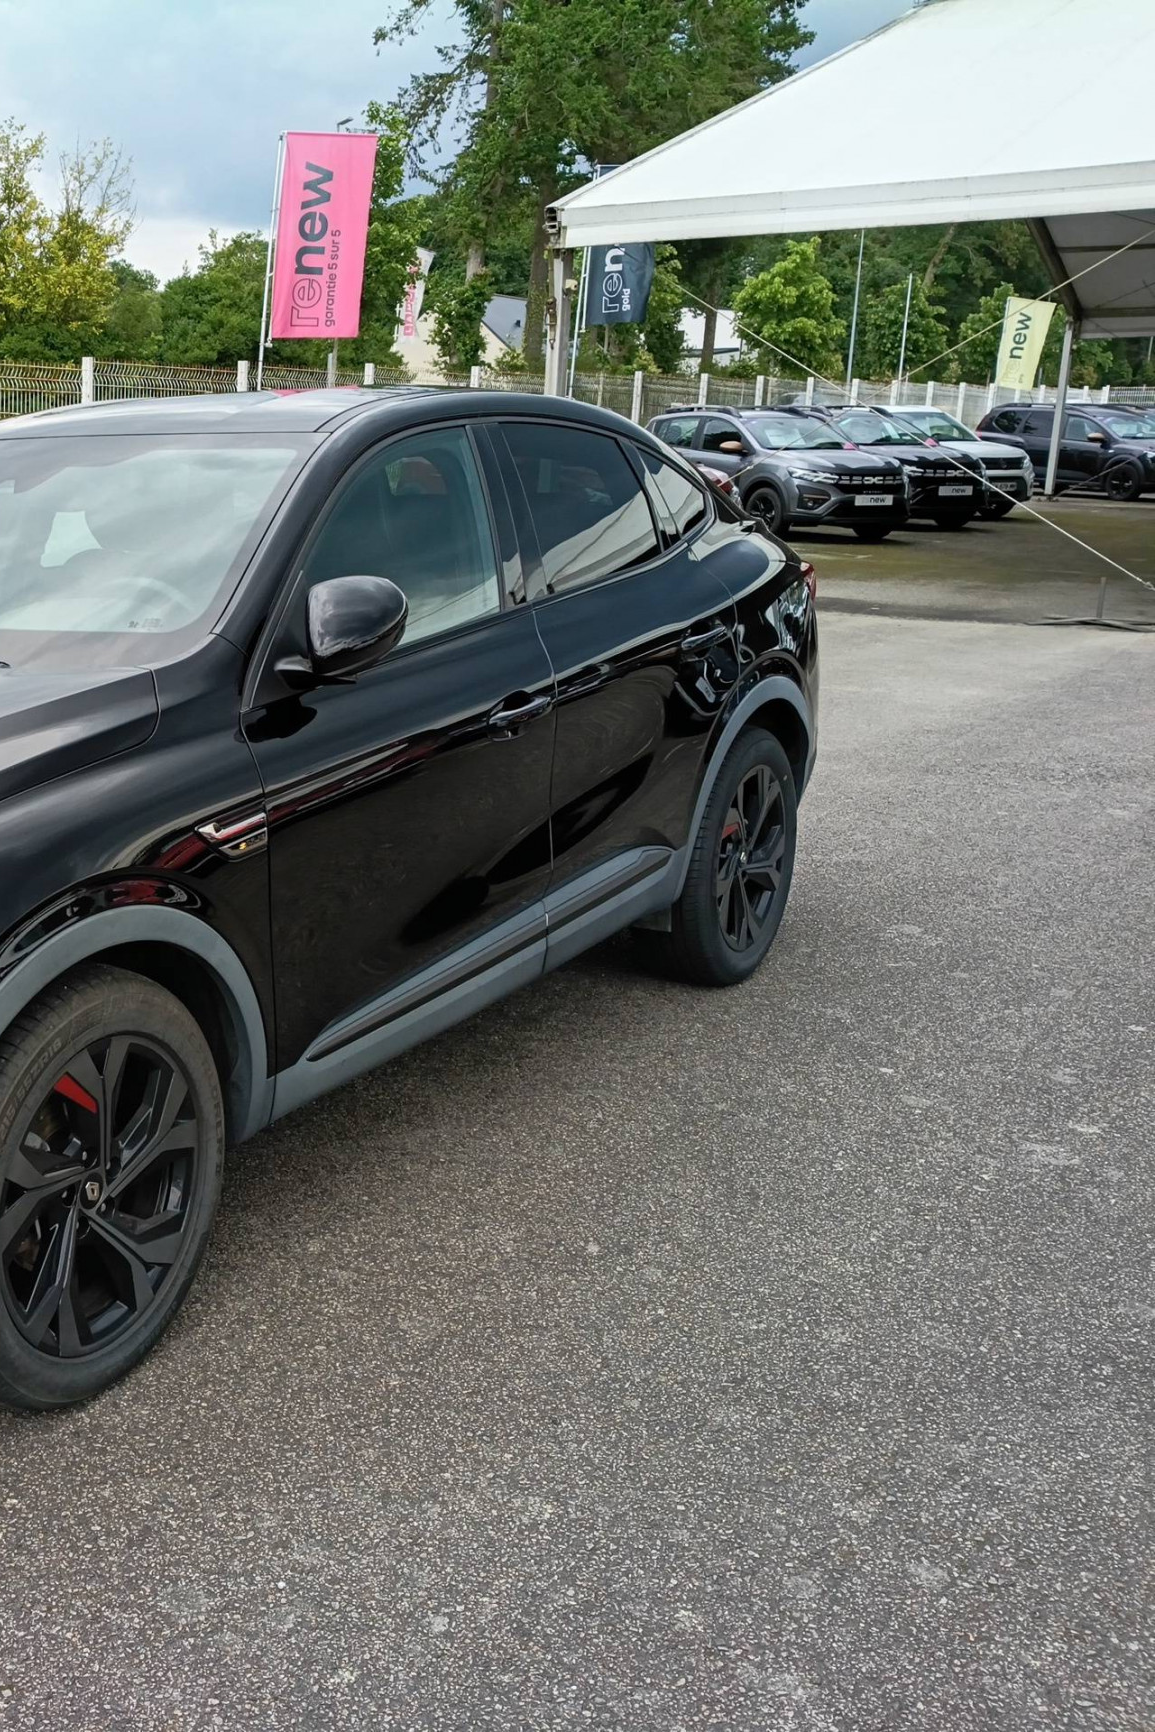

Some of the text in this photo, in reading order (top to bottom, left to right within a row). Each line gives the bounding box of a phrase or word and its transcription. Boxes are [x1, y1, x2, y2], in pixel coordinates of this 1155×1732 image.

[289, 161, 334, 328] renew
[324, 229, 342, 328] garantie 5 sur 5
[621, 288, 631, 312] gold
